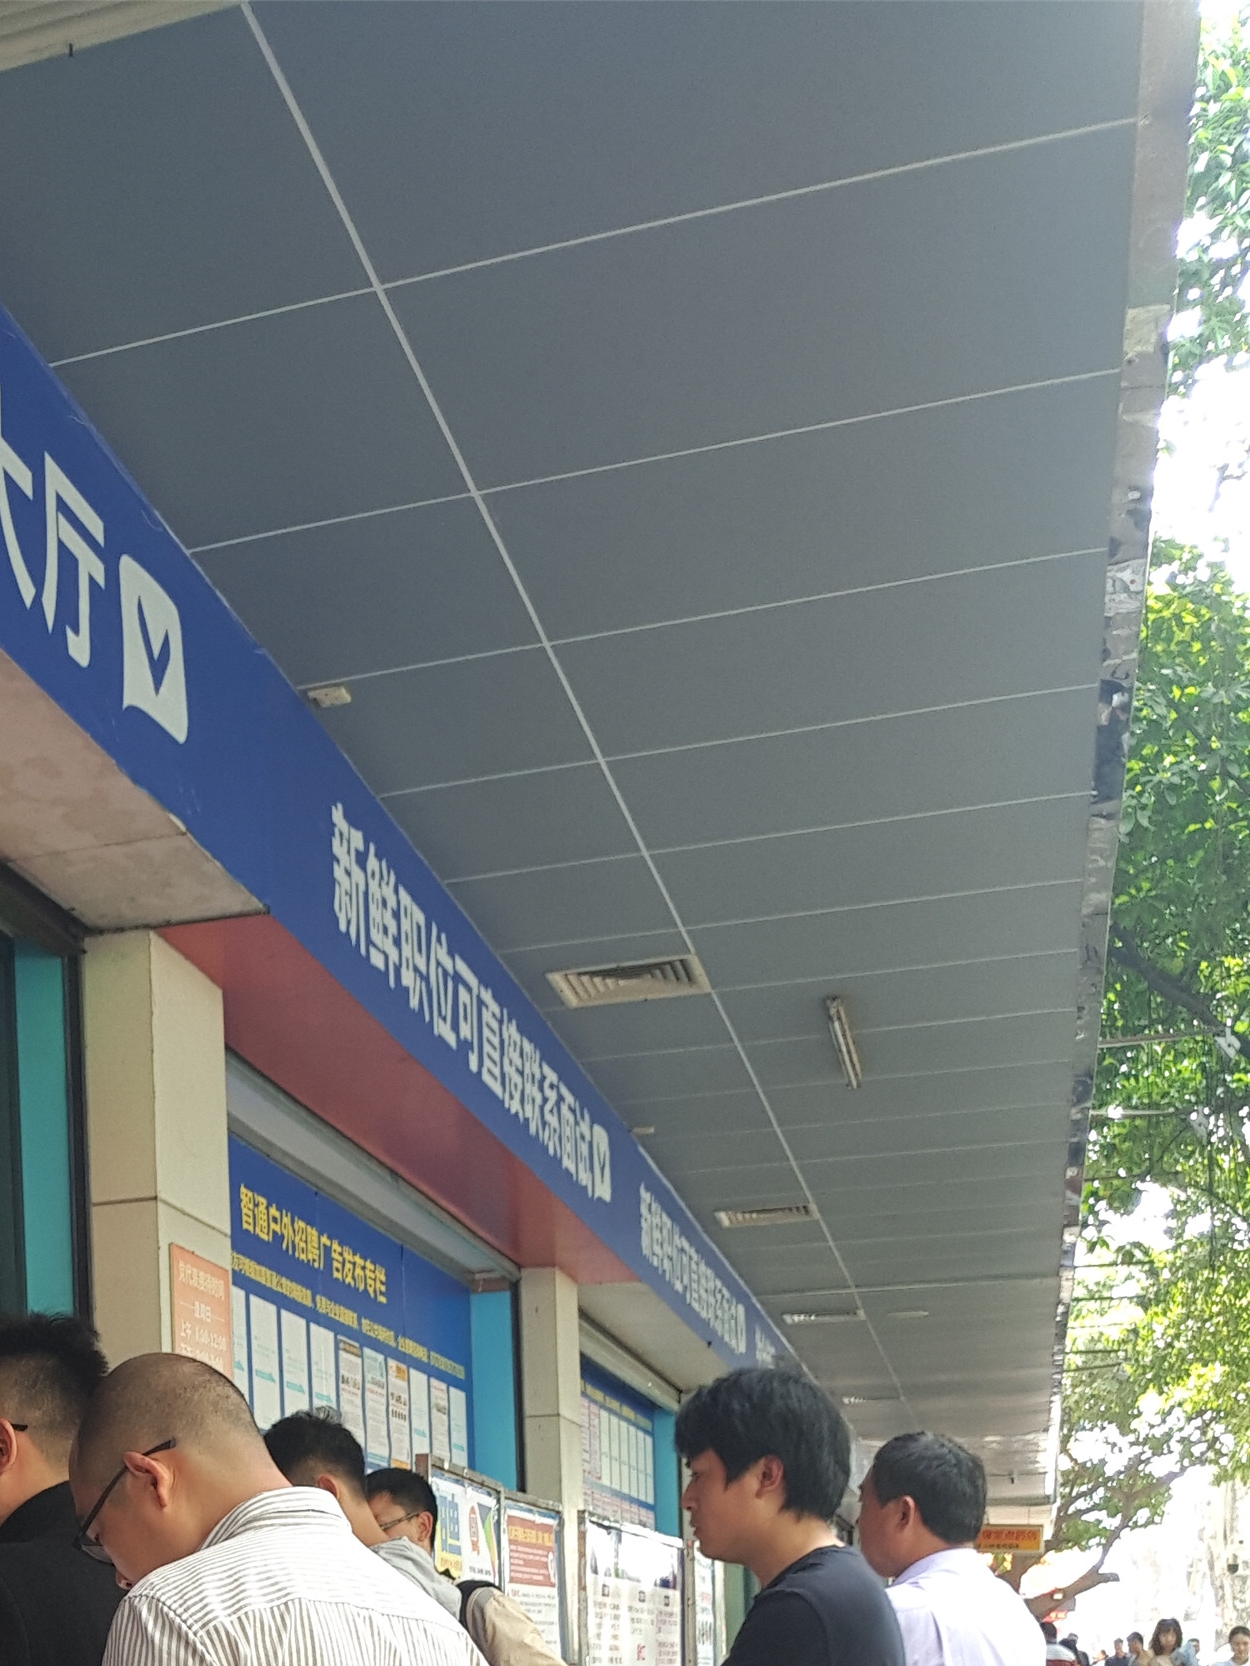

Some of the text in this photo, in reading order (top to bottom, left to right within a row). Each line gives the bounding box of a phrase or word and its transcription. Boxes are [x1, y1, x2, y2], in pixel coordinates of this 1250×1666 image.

[331, 801, 596, 1188] 新鲜职位可直接联系面试
[239, 1183, 388, 1304] 智通户外招聘广告发布专栏
